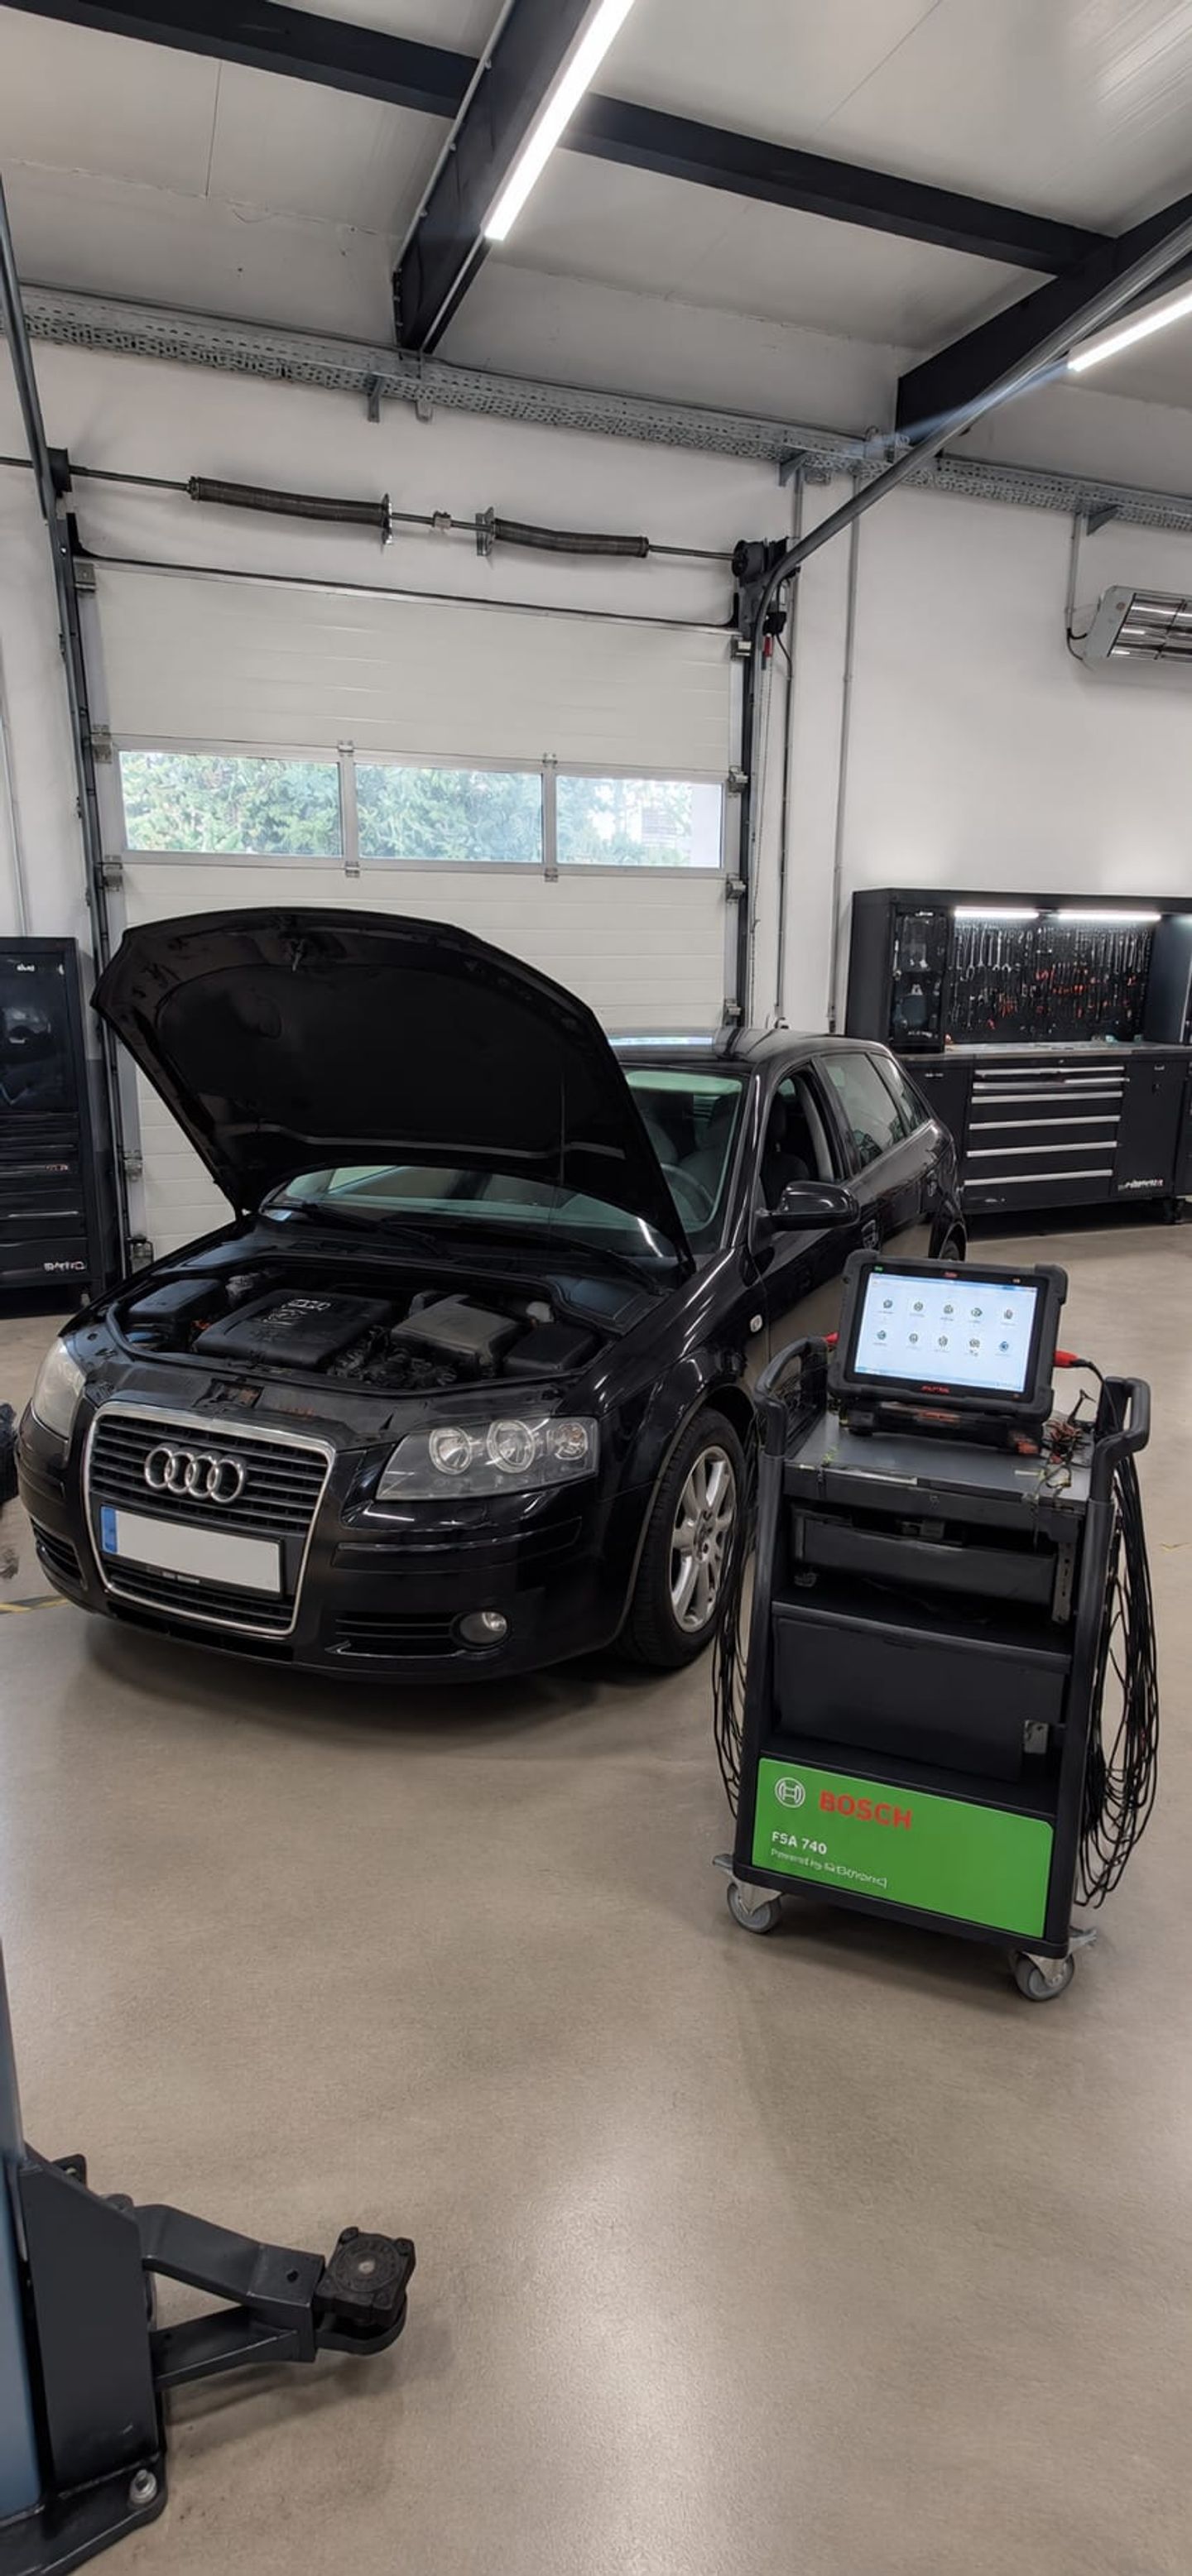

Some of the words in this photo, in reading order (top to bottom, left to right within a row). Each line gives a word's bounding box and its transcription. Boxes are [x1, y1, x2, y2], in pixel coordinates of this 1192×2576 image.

[819, 1789, 912, 1830] BOSCH
[771, 1831, 798, 1848] FSA
[801, 1838, 828, 1854] 740
